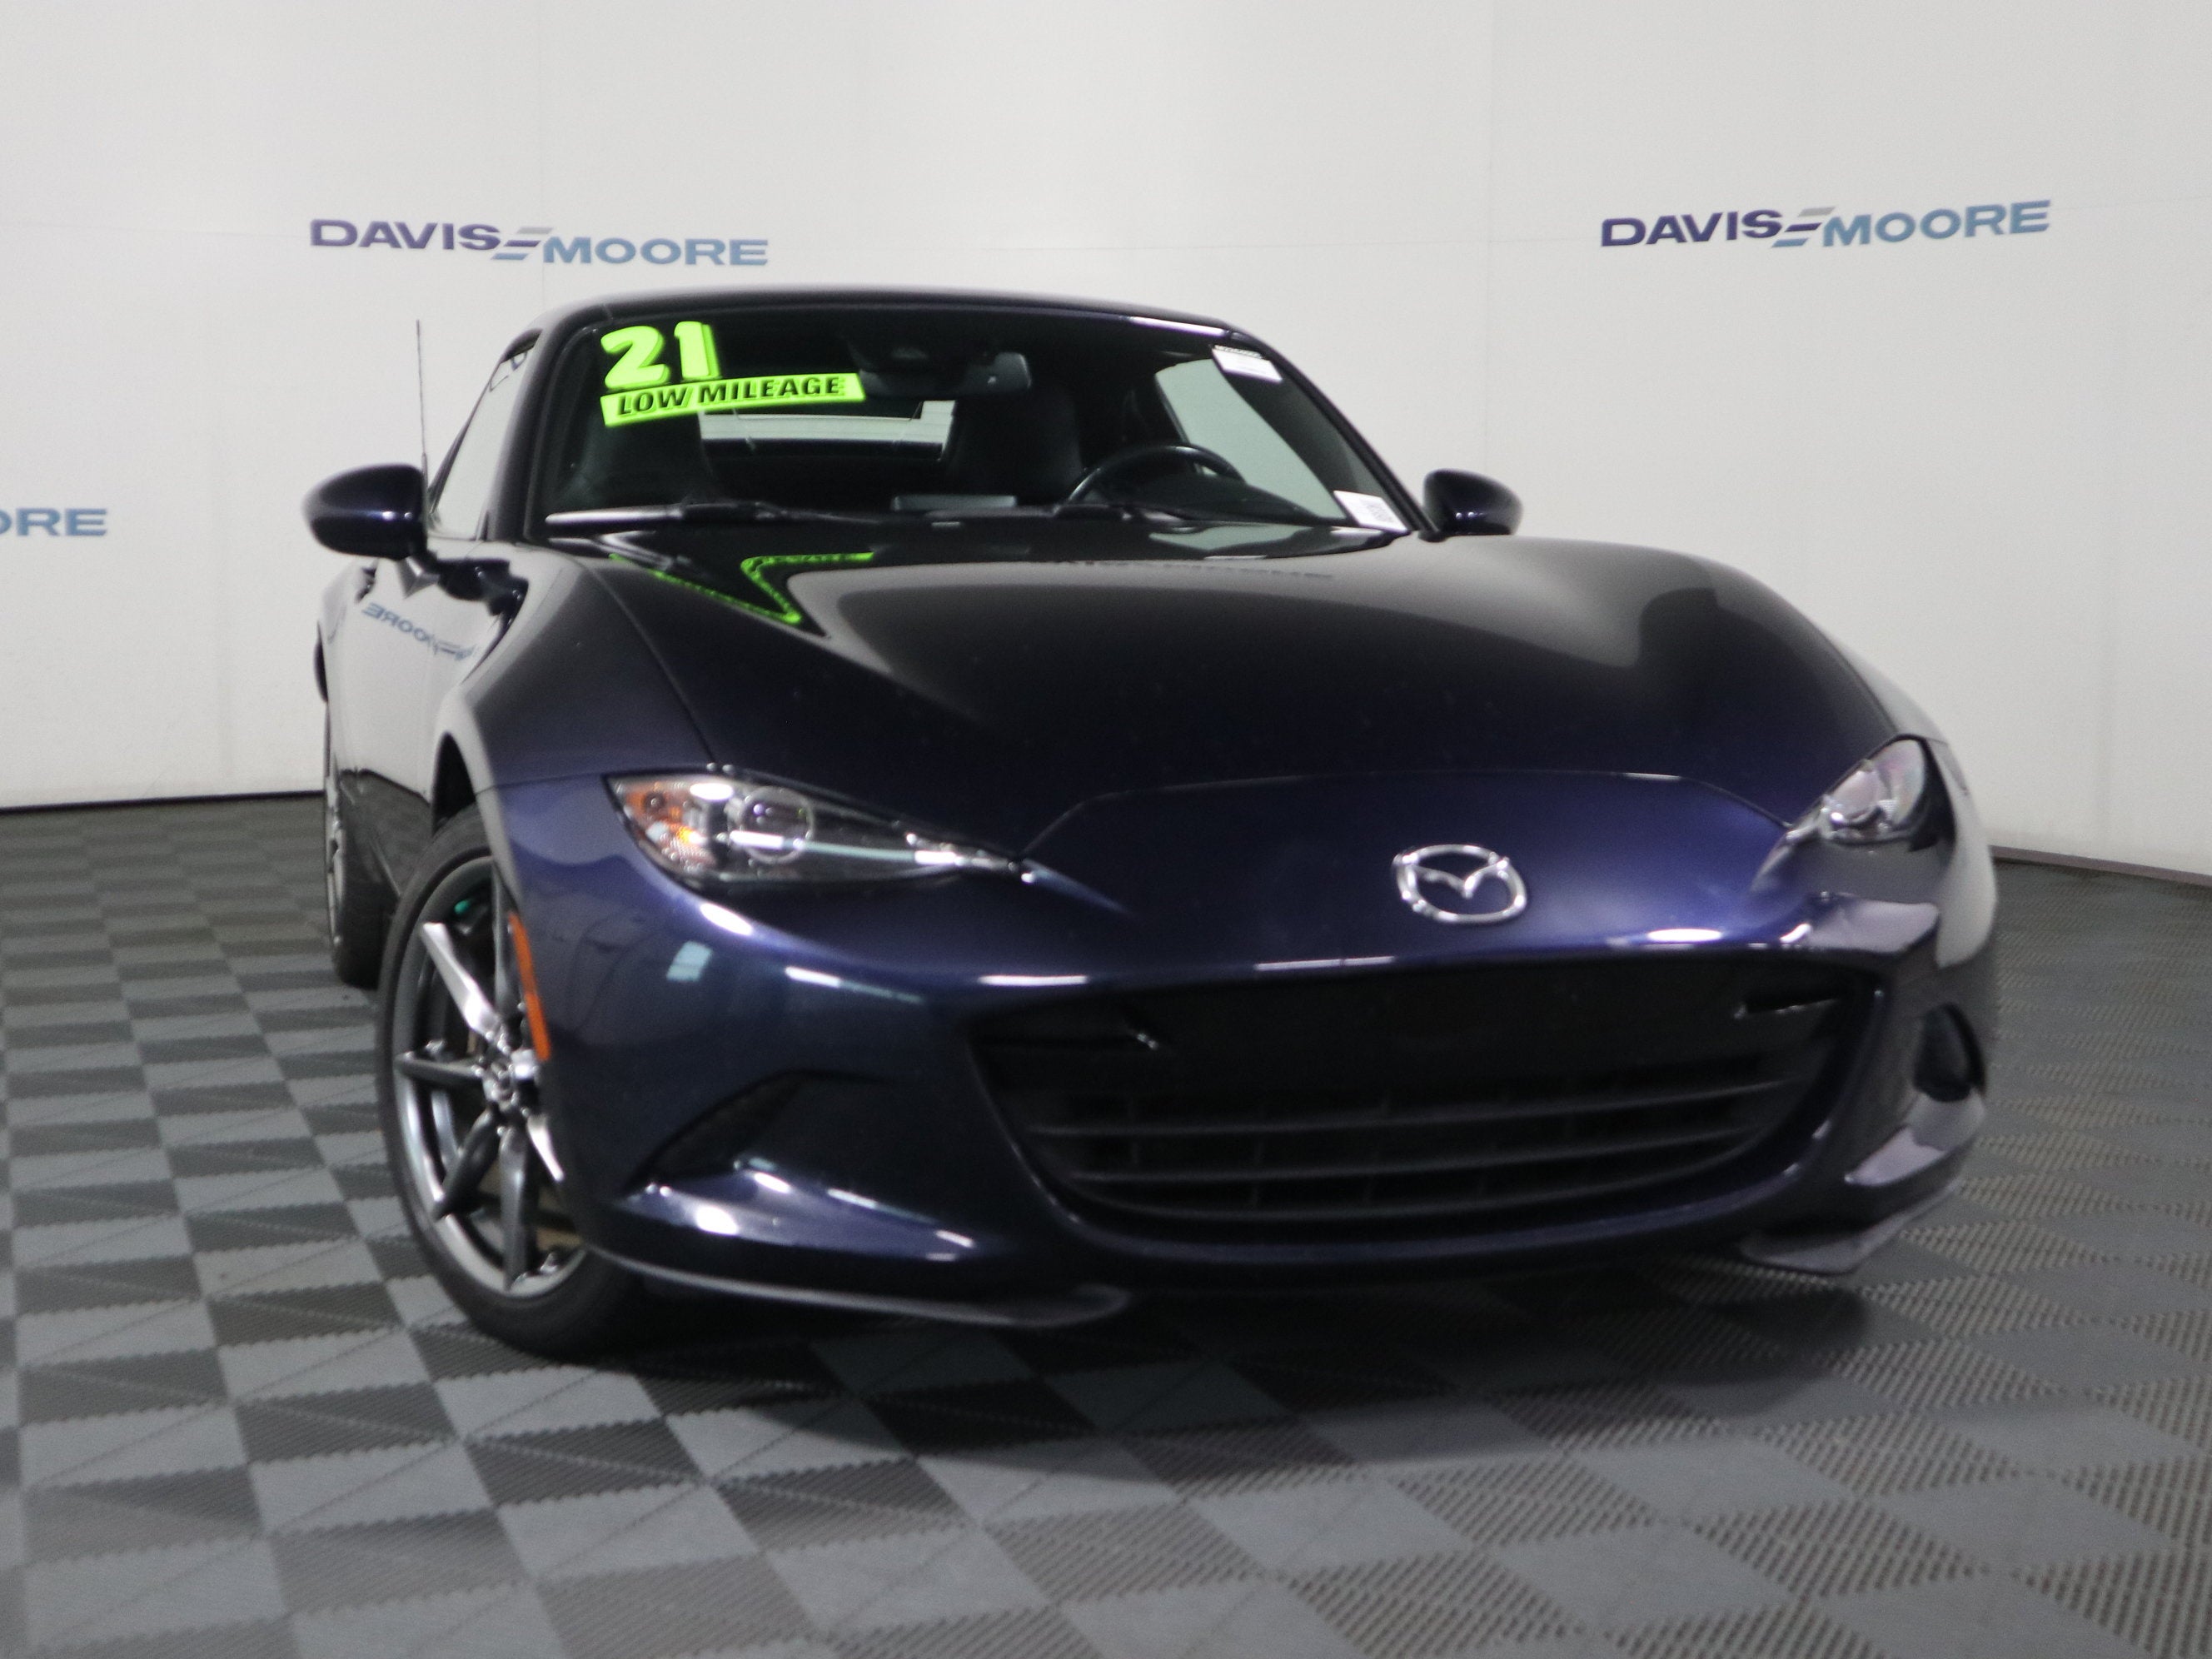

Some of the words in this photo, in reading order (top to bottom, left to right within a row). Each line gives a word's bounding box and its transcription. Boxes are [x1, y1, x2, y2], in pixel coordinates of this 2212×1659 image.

[310, 218, 501, 250] DAVIS
[543, 237, 769, 266] MOORE
[1601, 208, 1782, 247] DAVIS
[1822, 200, 2051, 247] MOORE
[600, 321, 720, 390] 21
[617, 386, 690, 416] LOW
[697, 376, 843, 404] MILEAGE
